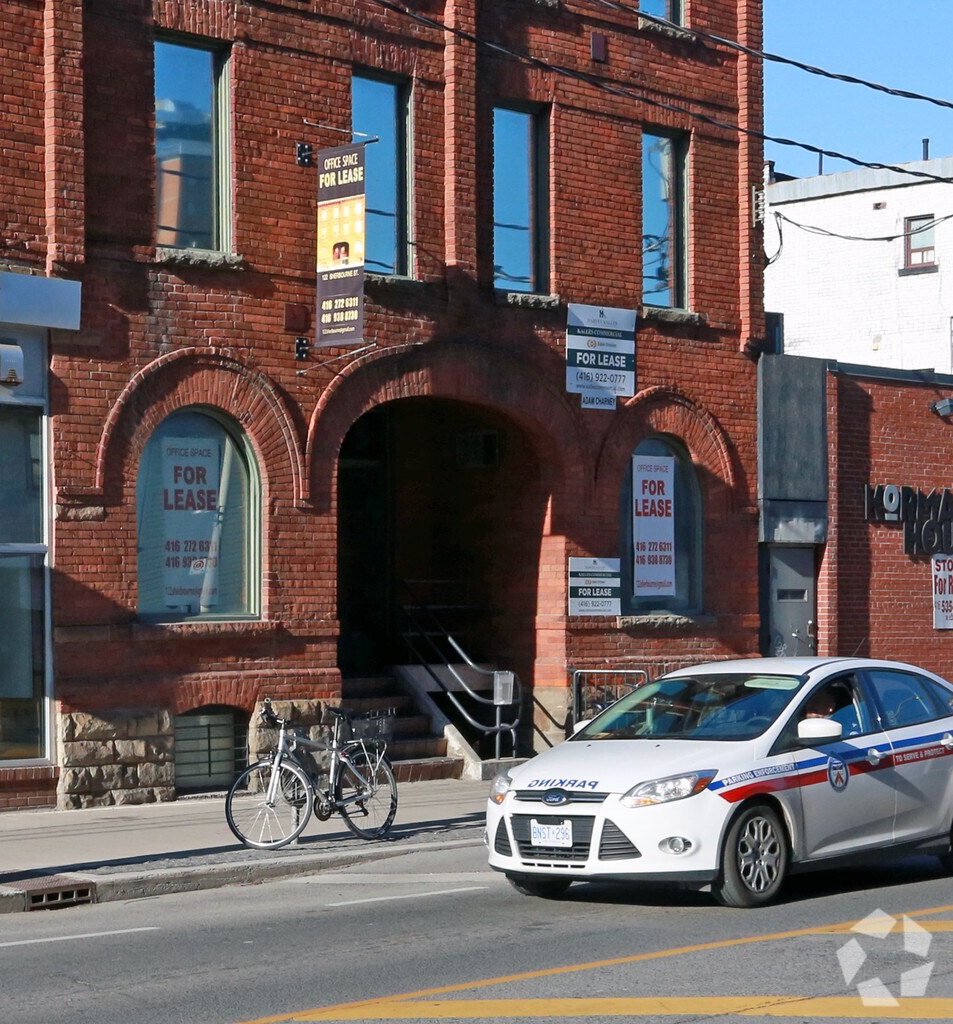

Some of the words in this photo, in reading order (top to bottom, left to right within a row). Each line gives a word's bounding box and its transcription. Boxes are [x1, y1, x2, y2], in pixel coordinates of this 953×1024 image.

[324, 155, 342, 171] OFFICE
[342, 153, 358, 166] SPACE
[319, 172, 336, 189] FOR
[338, 167, 364, 185] LEASE
[321, 299, 333, 310] 416
[334, 298, 345, 309] 272
[321, 312, 332, 324] 416
[576, 352, 596, 365] FOR
[598, 354, 626, 368] LEASE
[576, 371, 593, 382] (416)
[595, 373, 626, 384] 922-0777
[167, 448, 190, 458] OFFICE
[190, 448, 212, 458] SPACE
[637, 464, 653, 473] OFFICE
[653, 465, 669, 473] SPACE
[173, 466, 207, 485] FOR
[641, 480, 665, 495] FOR
[163, 489, 217, 511] LEASE
[634, 499, 672, 517] LEASE
[165, 540, 180, 553] 416
[184, 540, 197, 553] 272
[636, 541, 646, 552] 416
[648, 541, 658, 552] 272
[165, 556, 180, 568] 416
[636, 555, 646, 565] 416
[934, 575, 947, 595] For
[578, 588, 591, 596] FOR
[592, 588, 612, 597] LEASE
[578, 600, 591, 608] (416)
[591, 600, 612, 608] 922-0777
[895, 755, 903, 763] TO
[903, 751, 920, 761] SERVE
[722, 771, 753, 787] PARKING
[753, 763, 795, 778] ENFORCEMENT
[546, 794, 561, 802] Ford
[532, 826, 551, 840] BNST
